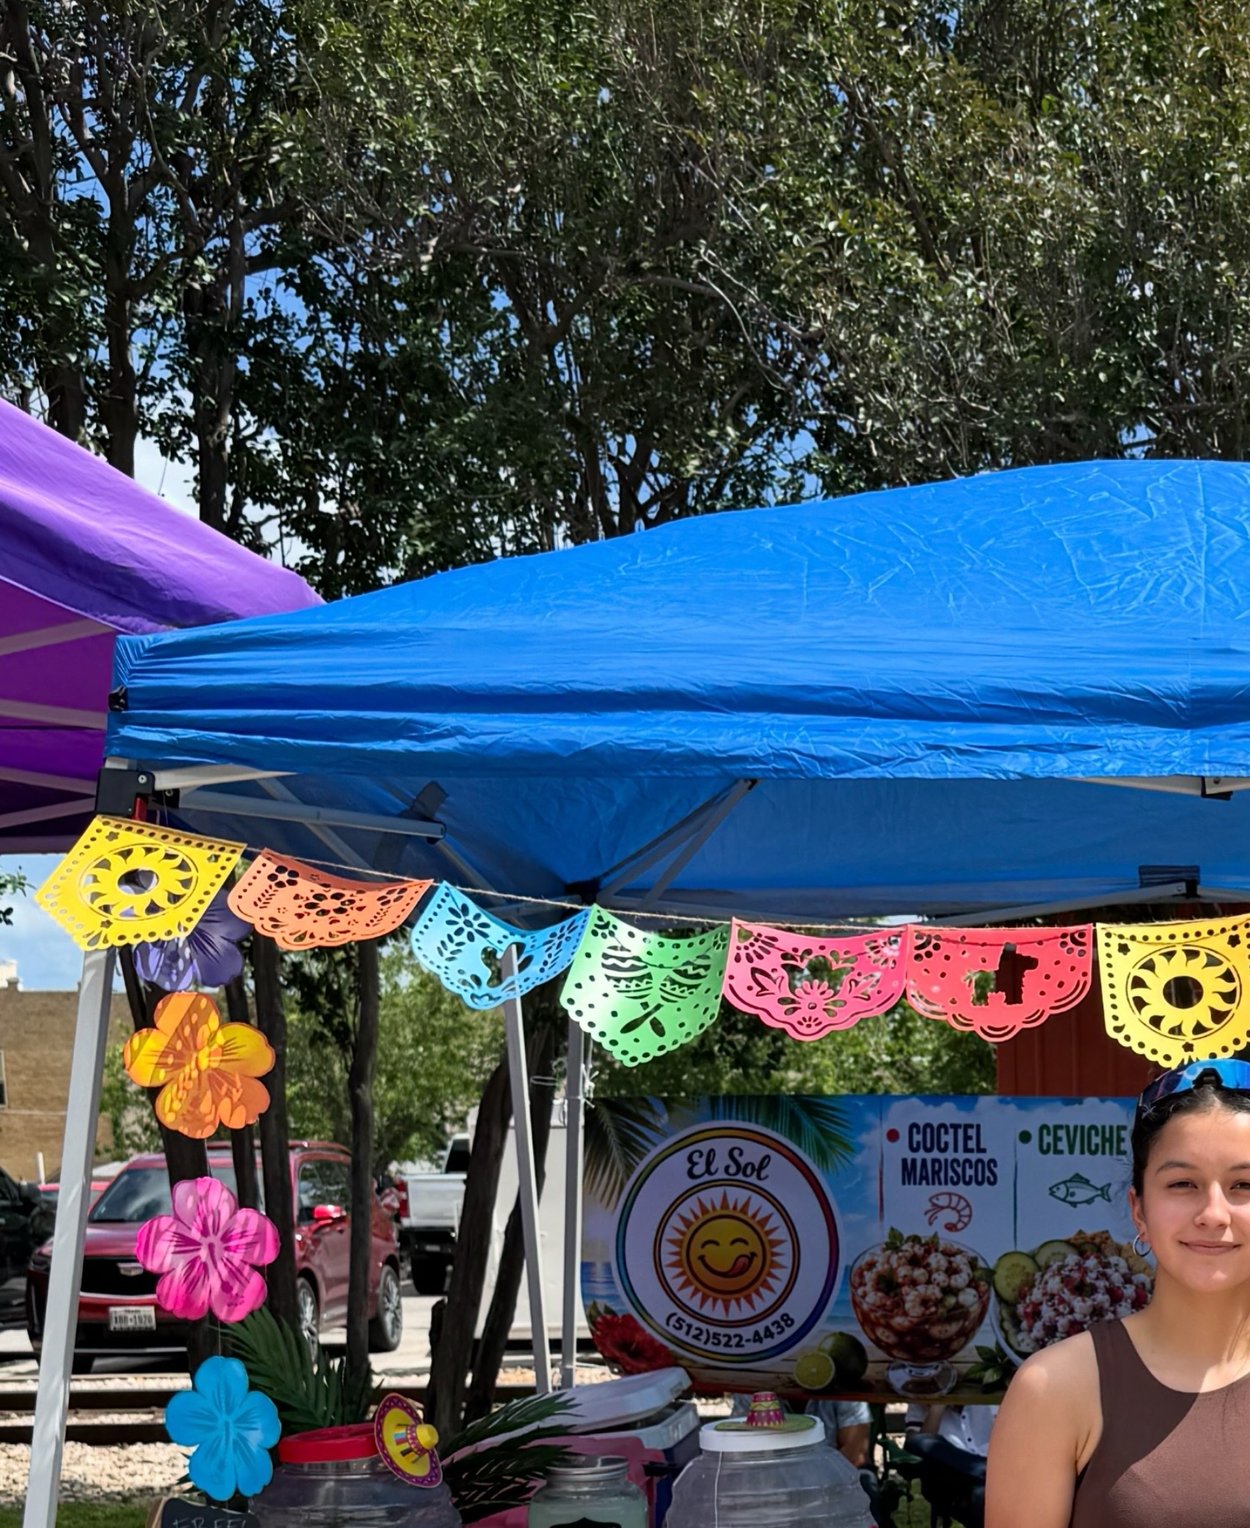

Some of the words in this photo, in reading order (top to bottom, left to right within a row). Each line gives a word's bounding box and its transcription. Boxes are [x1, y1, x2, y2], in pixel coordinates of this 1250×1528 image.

[908, 1122, 987, 1154] COCTEL
[1038, 1124, 1128, 1156] CEVICHE
[686, 1148, 718, 1180] El
[724, 1146, 771, 1181] Sol
[901, 1157, 998, 1187] MARISCOS
[666, 1312, 795, 1348] (512)522-4438
